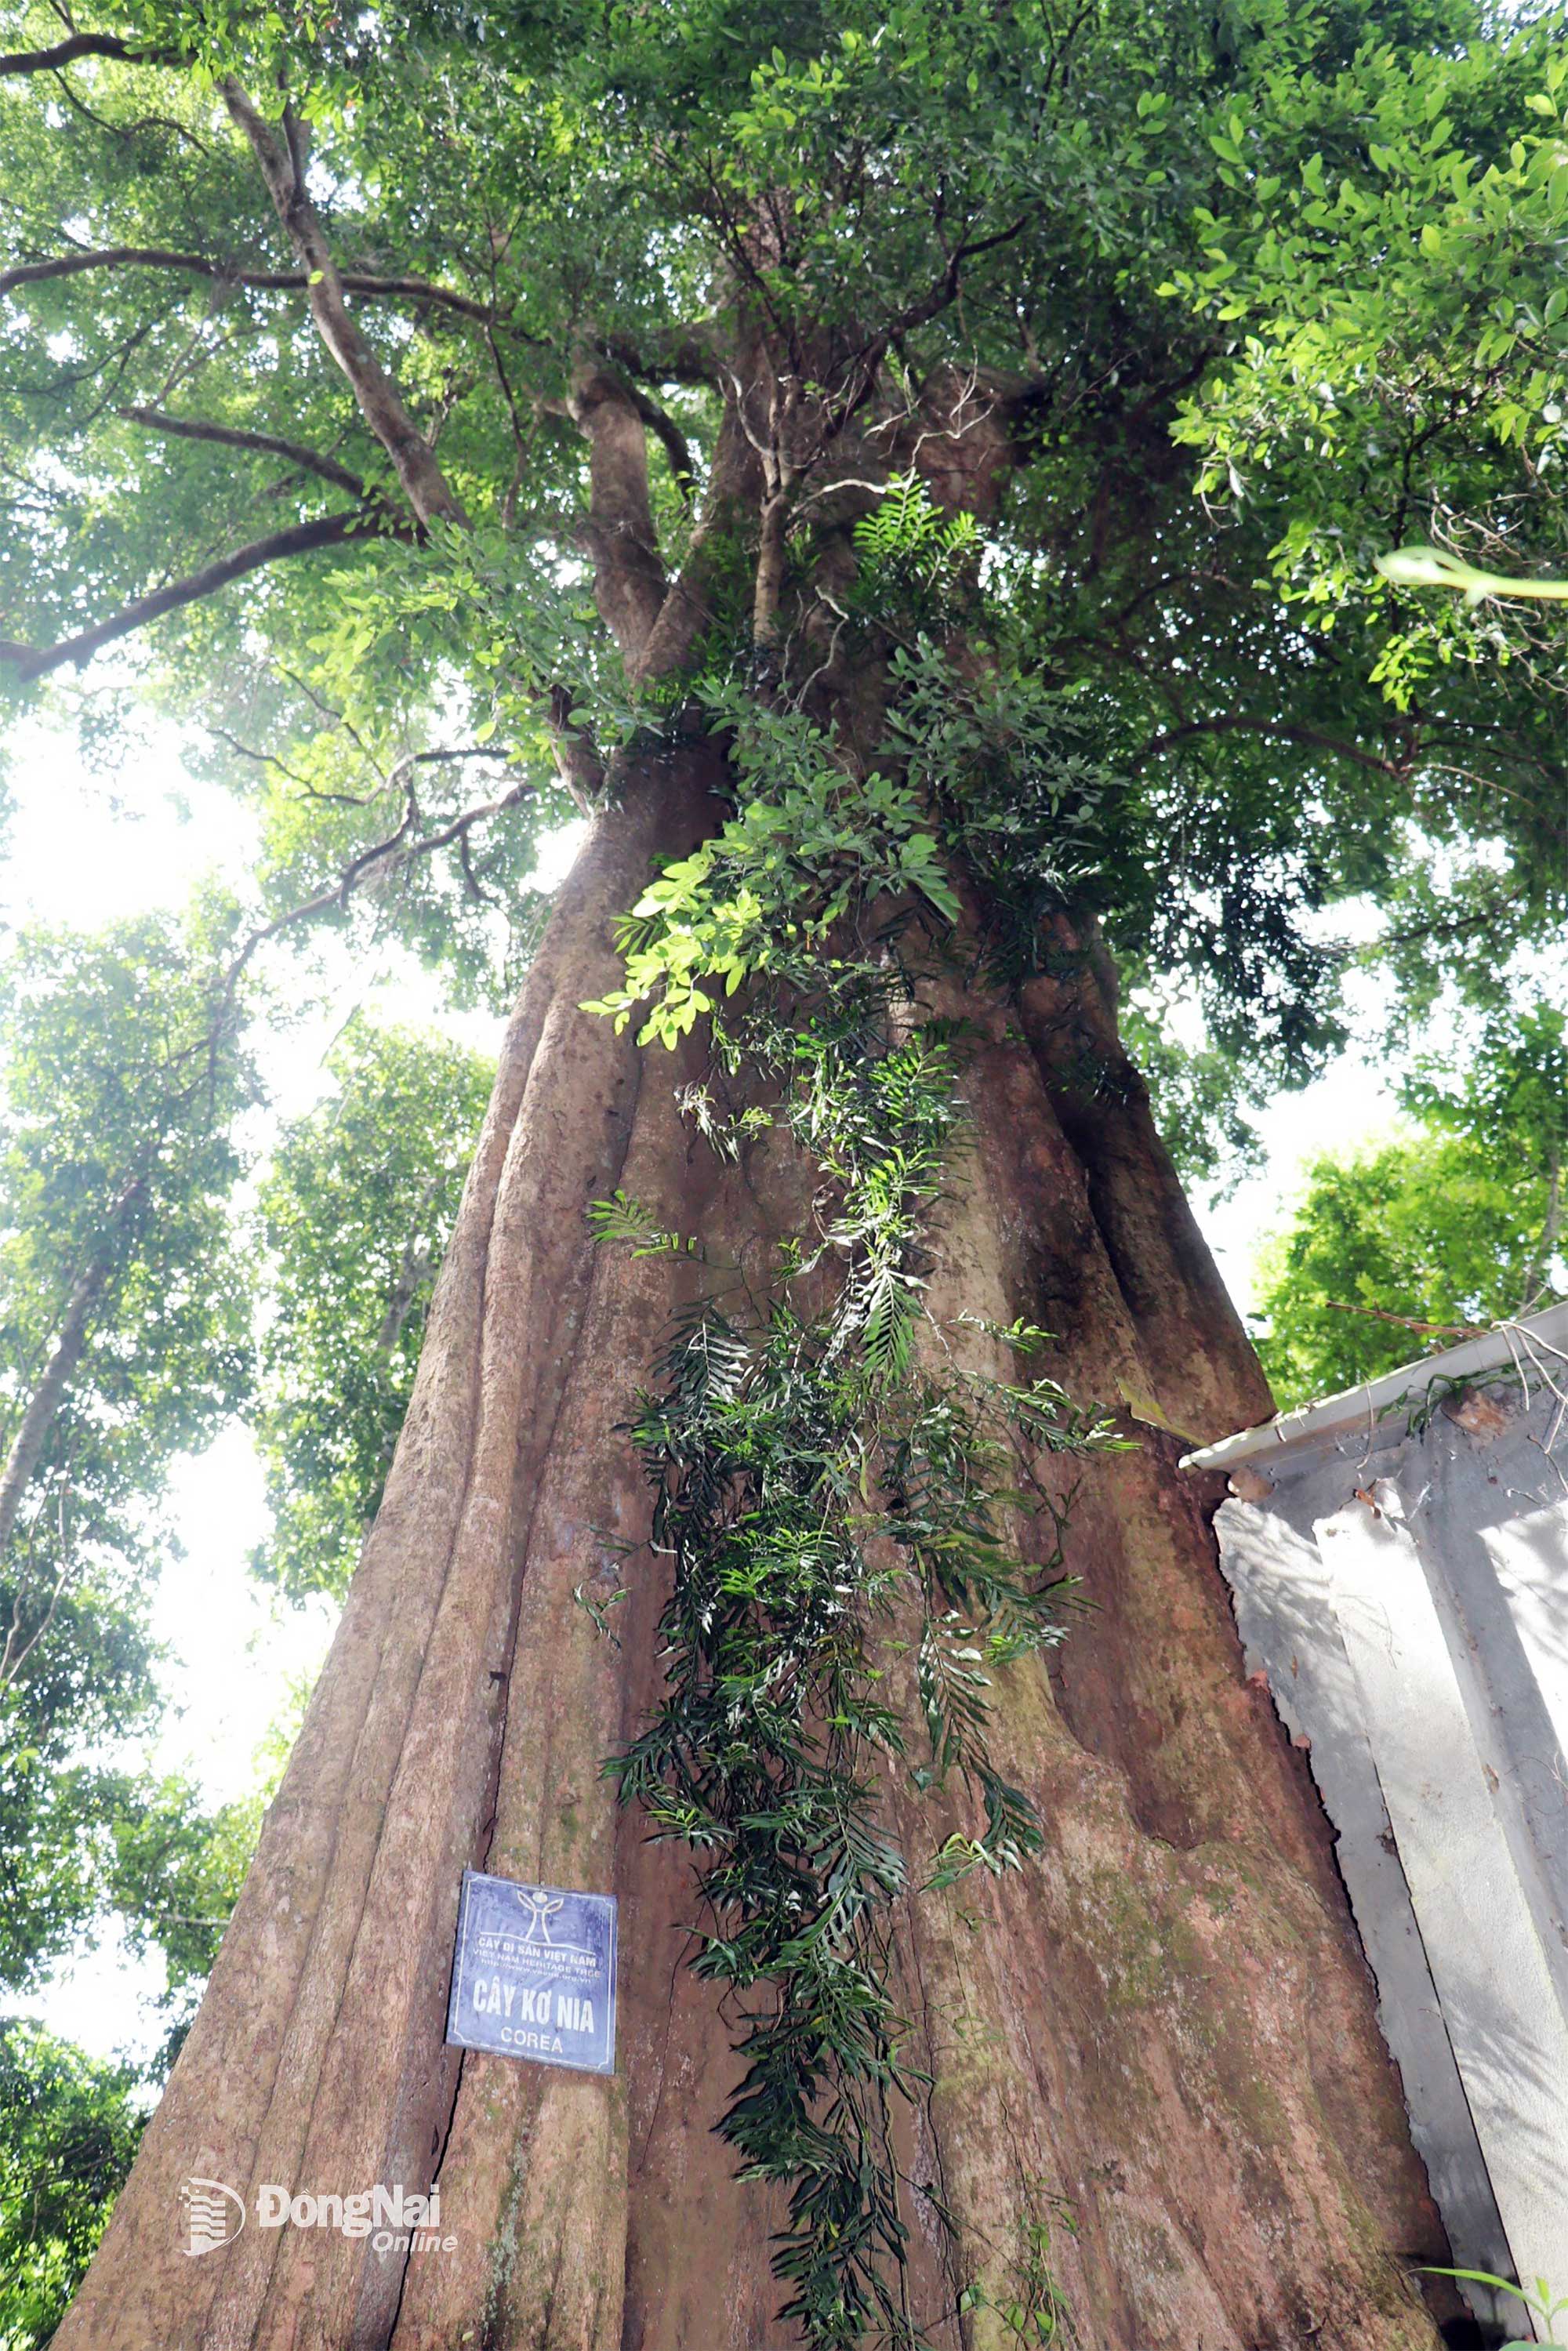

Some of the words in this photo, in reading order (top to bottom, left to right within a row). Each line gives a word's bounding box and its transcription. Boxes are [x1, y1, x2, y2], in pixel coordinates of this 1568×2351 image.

[498, 1953, 519, 1963] NAM
[522, 1958, 572, 1973] HERITAGE
[575, 1967, 602, 1978] TREE
[570, 1953, 597, 1968] NAM
[473, 1975, 517, 2018] CÂY
[521, 1988, 552, 2025] KƠ
[557, 1994, 594, 2034] NIA
[500, 2026, 563, 2054] COREA
